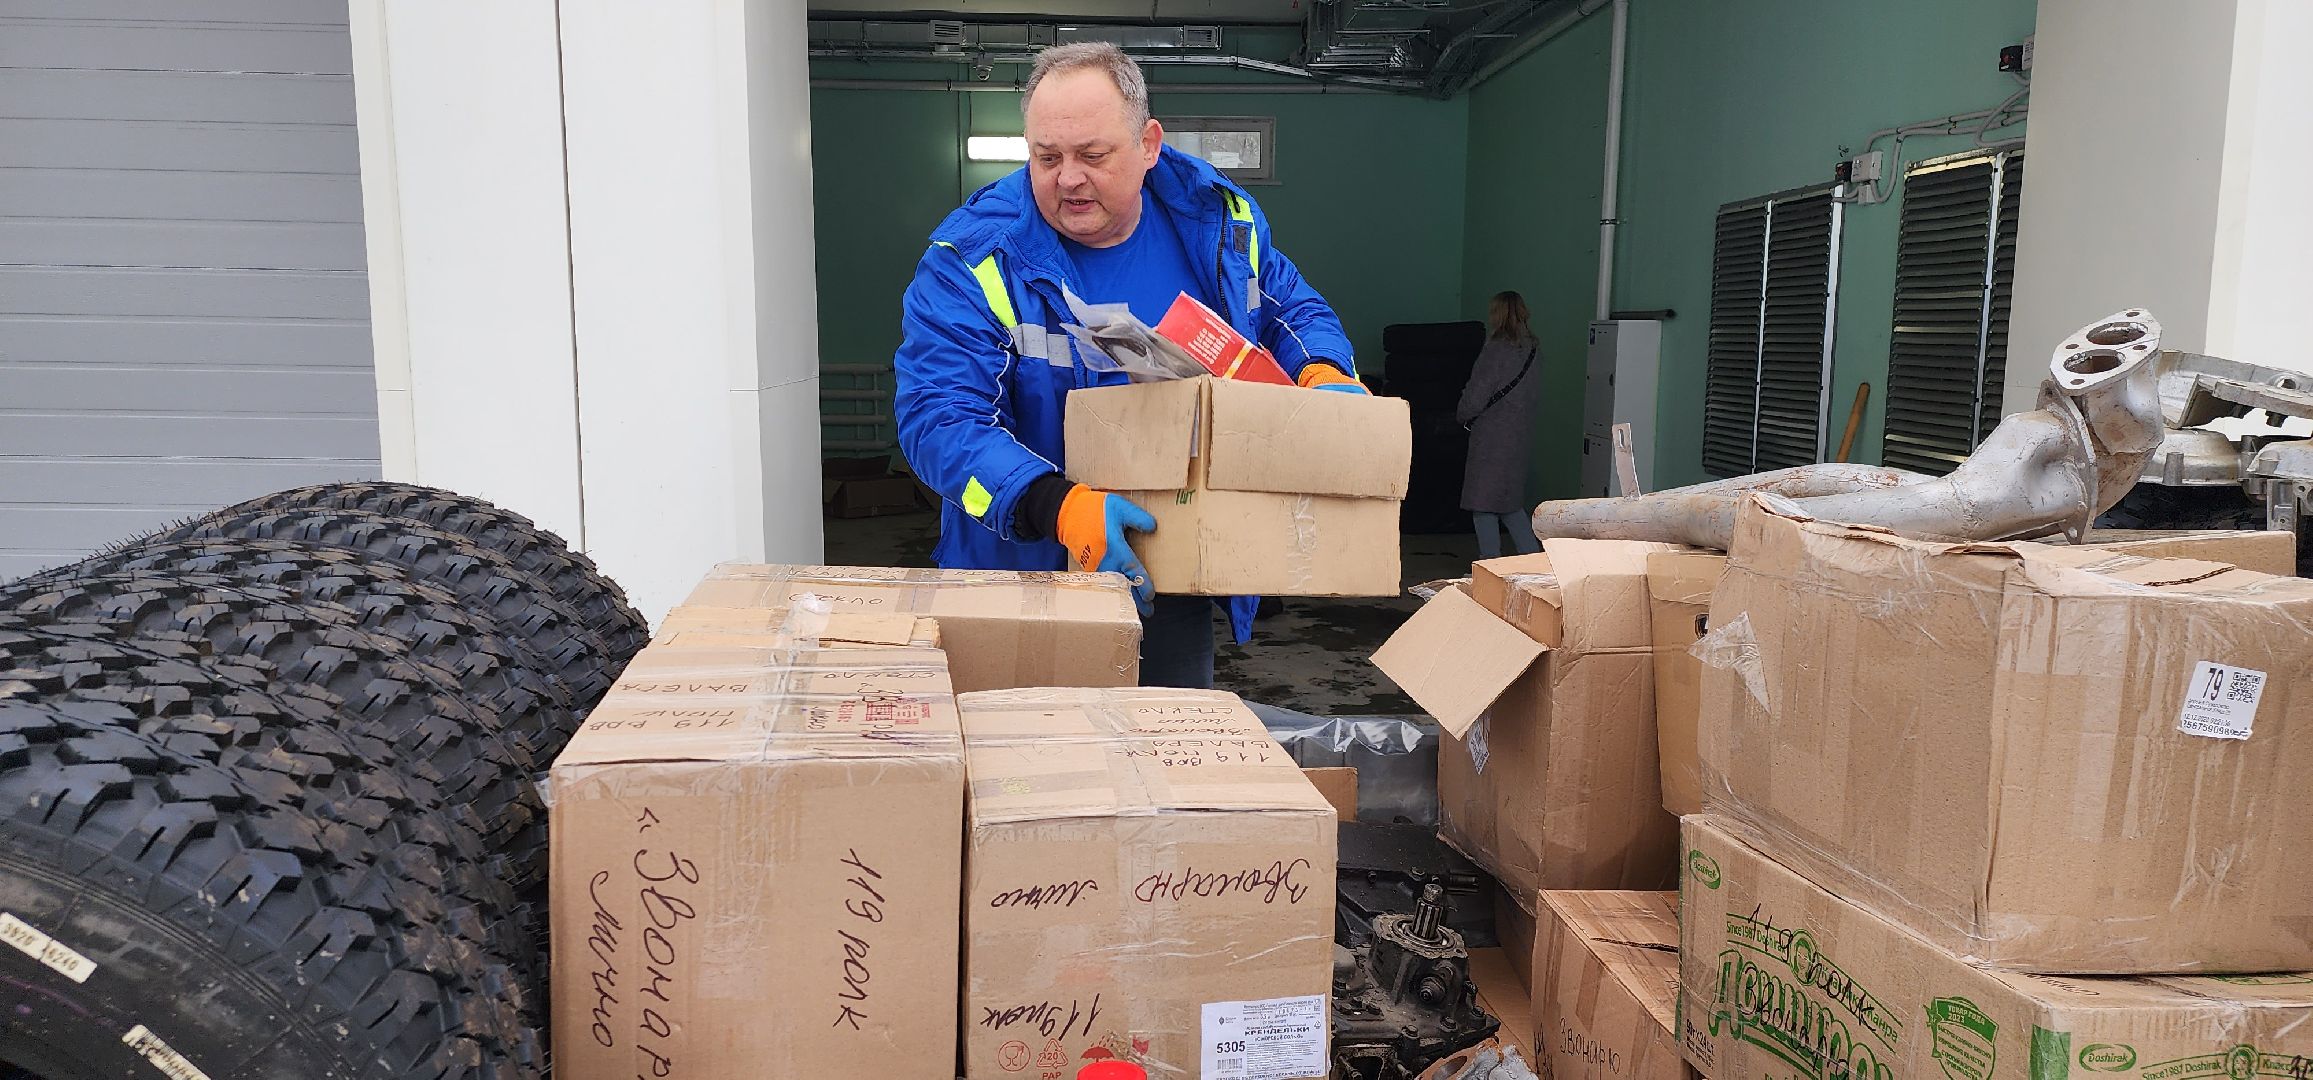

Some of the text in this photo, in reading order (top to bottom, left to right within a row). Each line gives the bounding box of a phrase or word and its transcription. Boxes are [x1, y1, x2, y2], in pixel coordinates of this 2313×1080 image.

[2202, 668, 2224, 701] 79
[1215, 751, 1271, 762] 119
[839, 848, 883, 923] 119
[1216, 1040, 1246, 1054] 5305
[1047, 1052, 1059, 1061] 20
[2088, 1053, 2129, 1064] Doshirak
[1042, 1072, 1062, 1080] PAP
